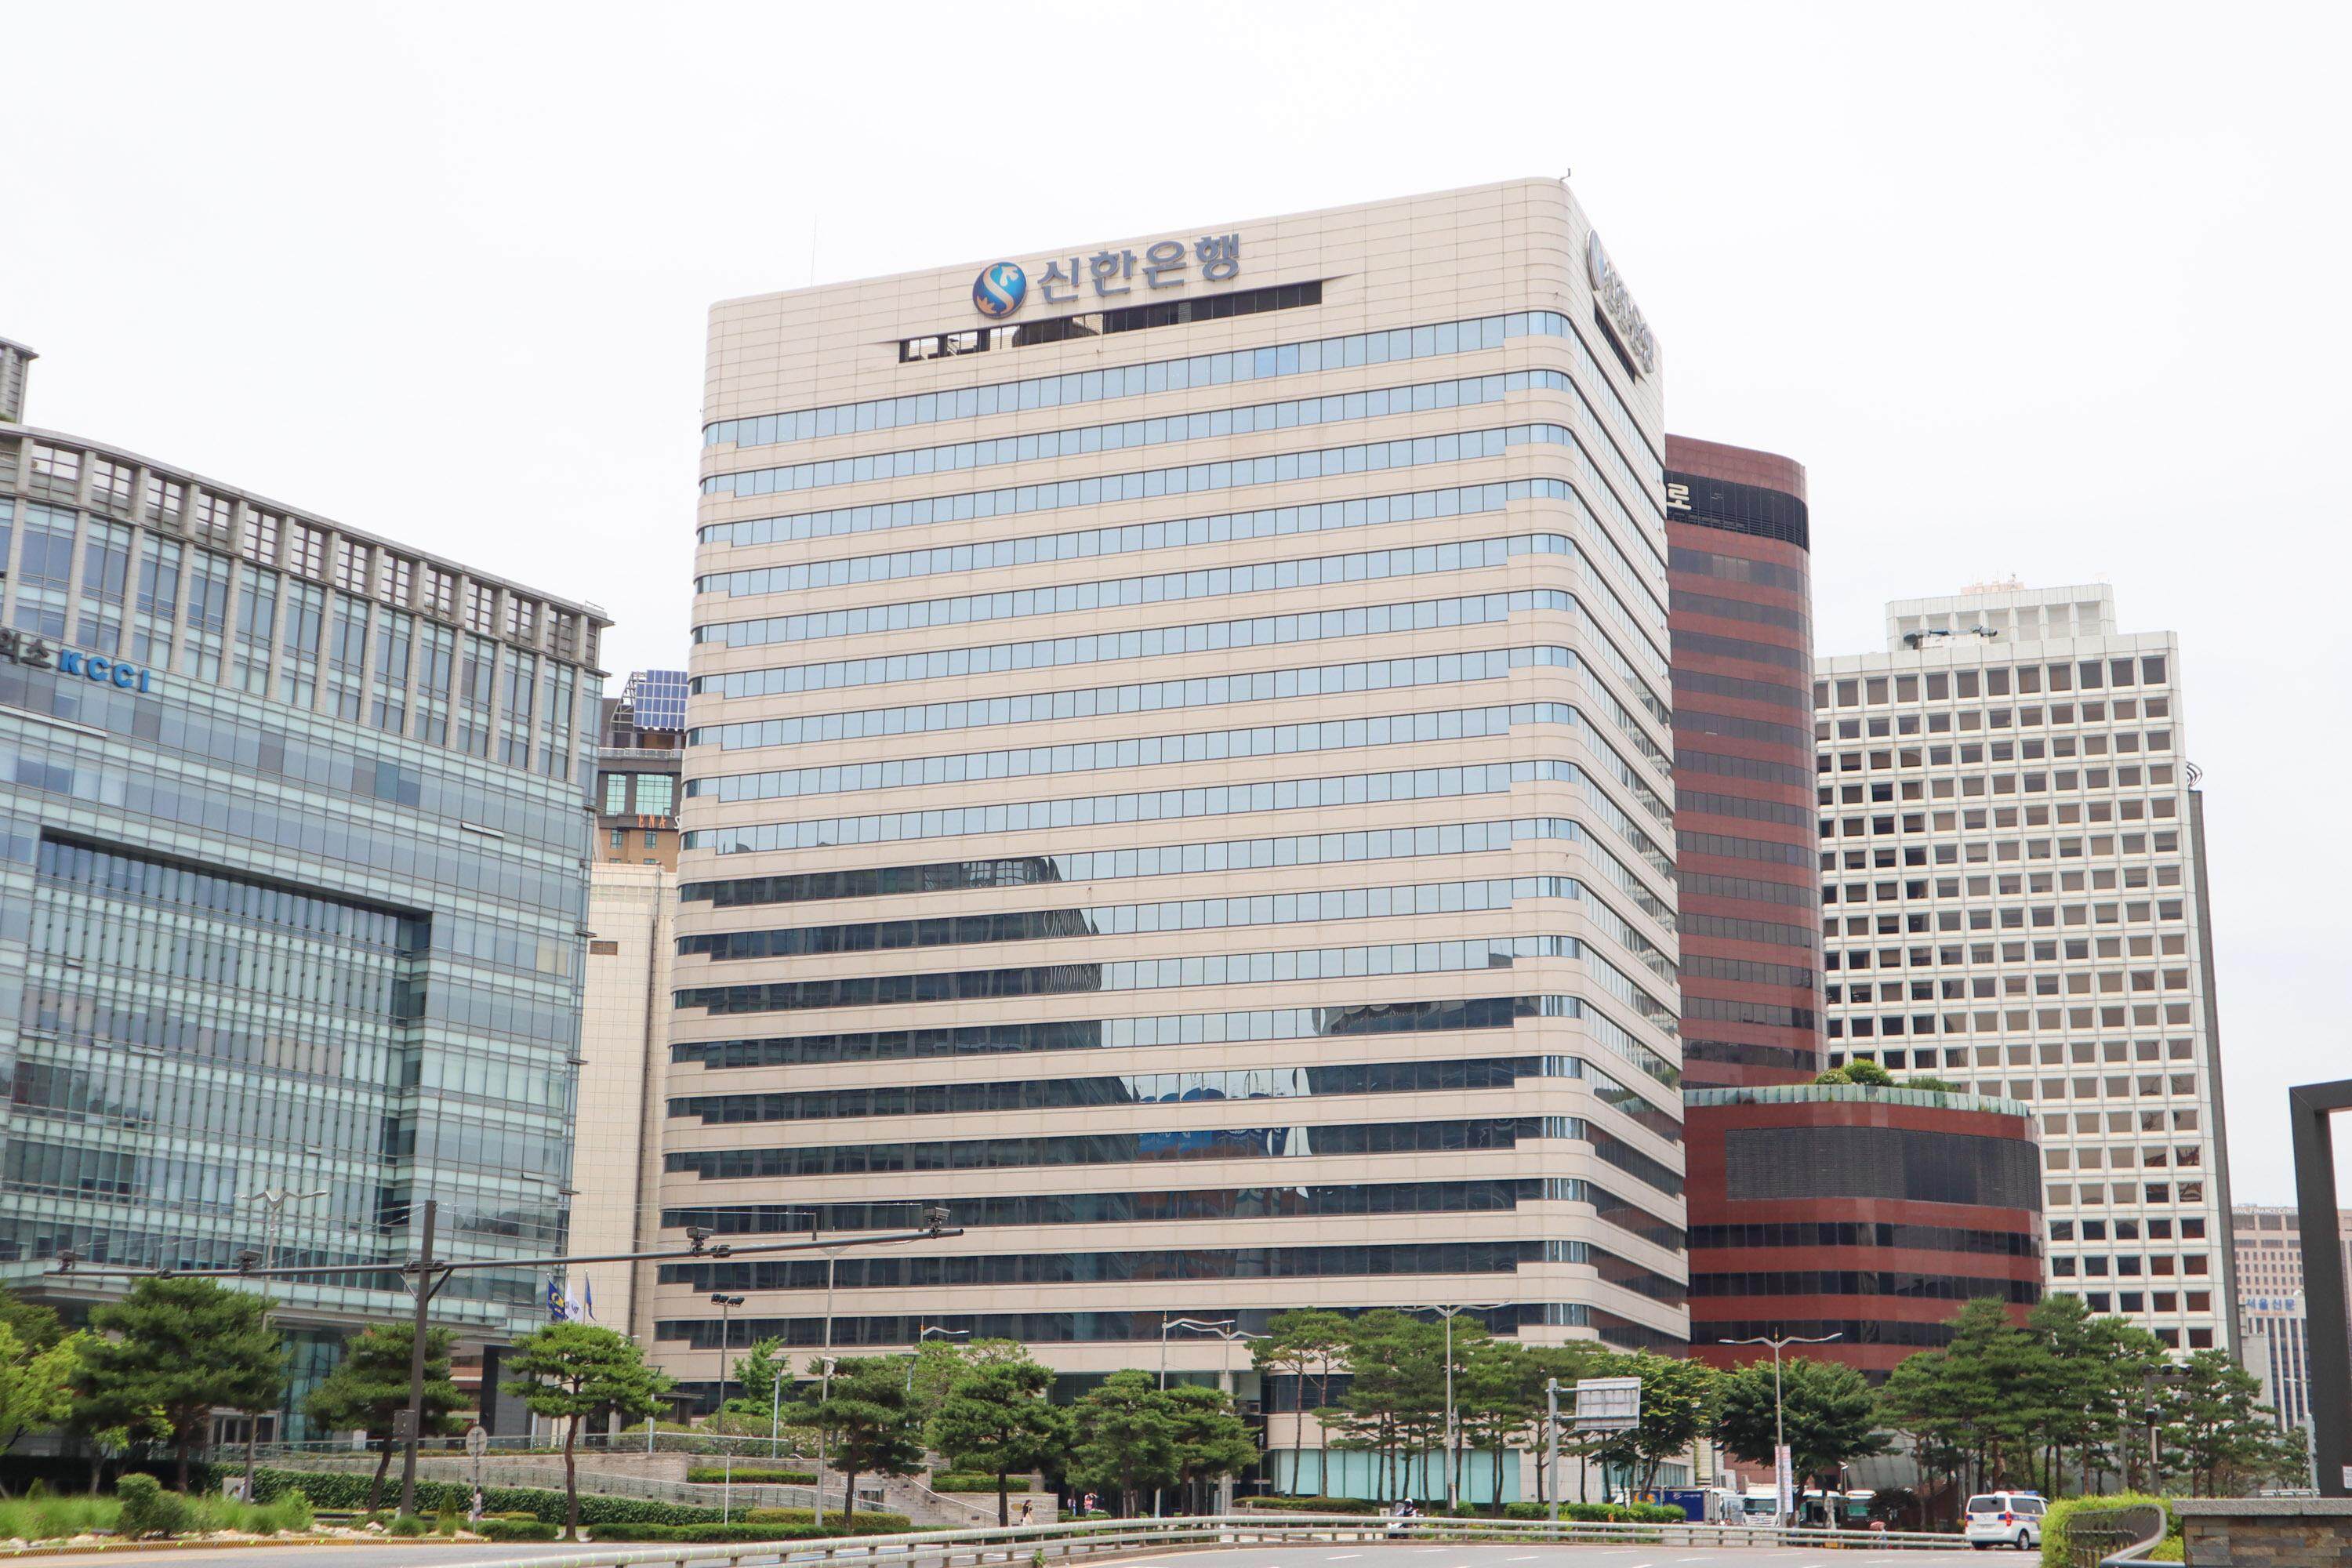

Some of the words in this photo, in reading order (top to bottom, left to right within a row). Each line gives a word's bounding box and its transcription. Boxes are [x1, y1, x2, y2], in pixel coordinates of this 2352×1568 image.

[1037, 233, 1240, 304] 신한은행
[60, 648, 151, 693] KCCI
[638, 813, 666, 828] ENA
[2246, 1298, 2295, 1310] 서울신문
